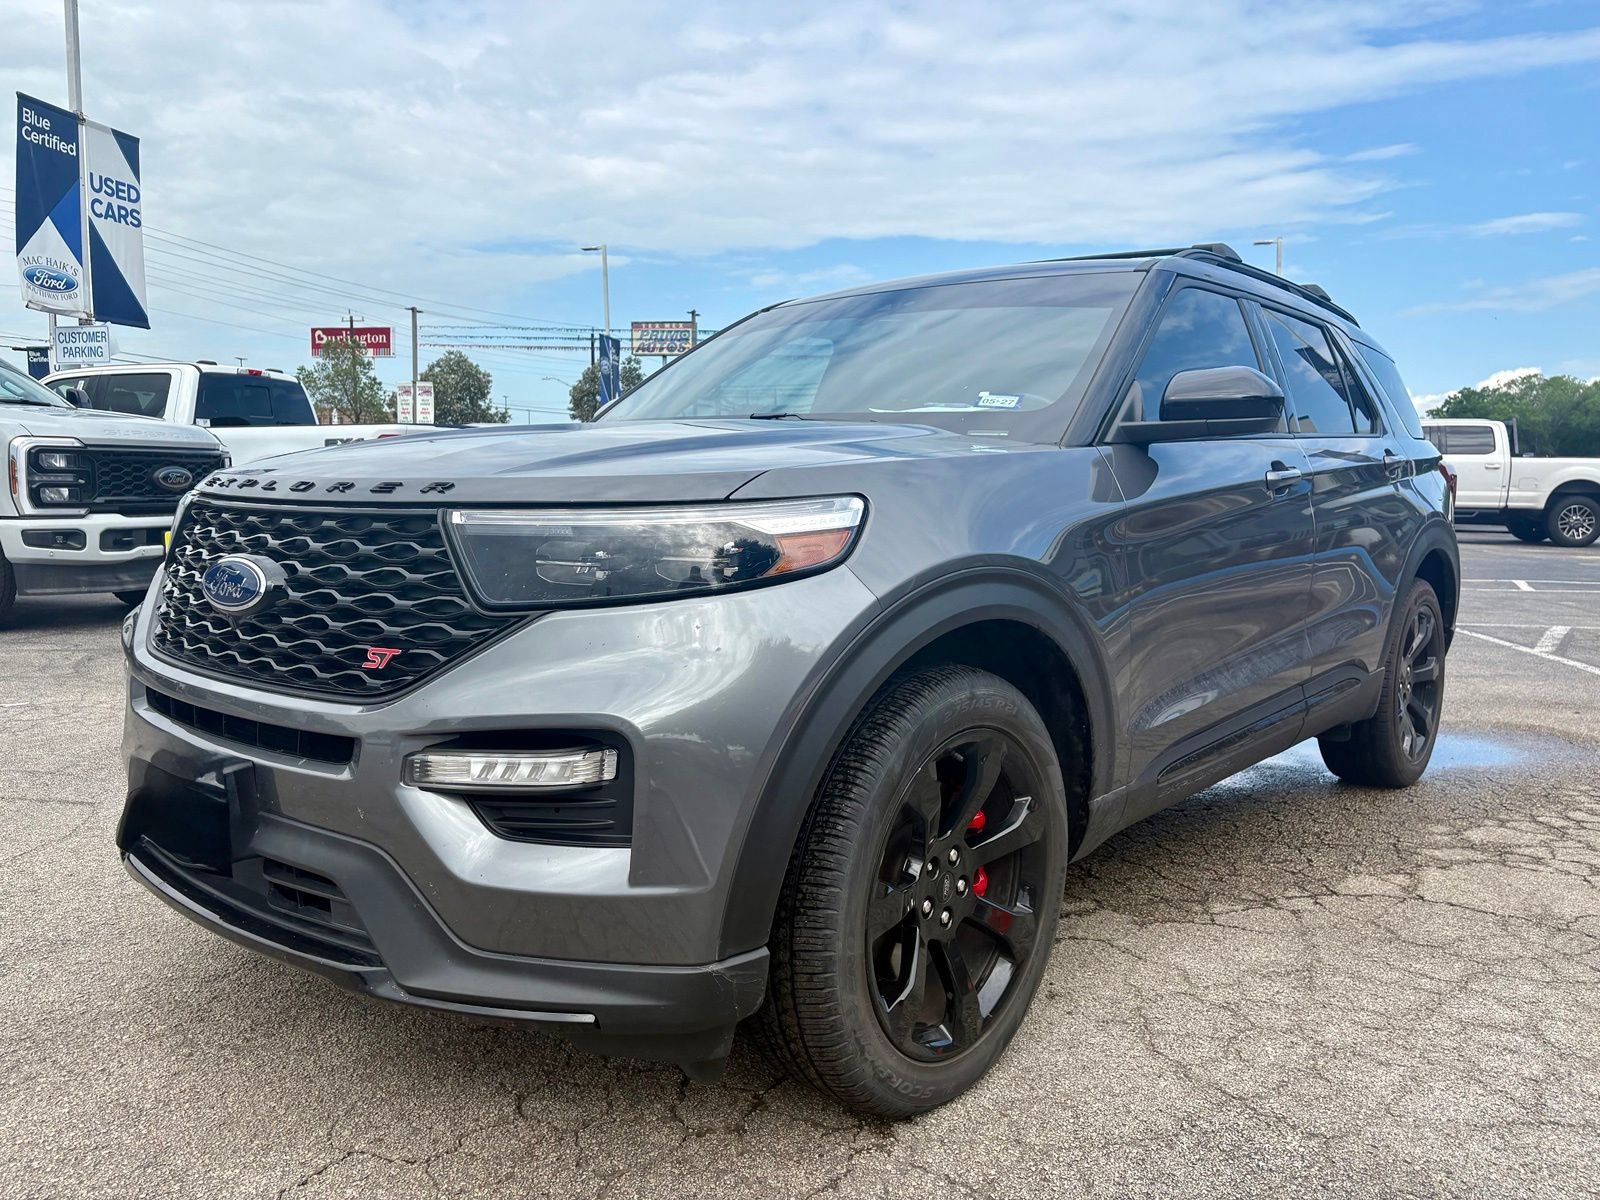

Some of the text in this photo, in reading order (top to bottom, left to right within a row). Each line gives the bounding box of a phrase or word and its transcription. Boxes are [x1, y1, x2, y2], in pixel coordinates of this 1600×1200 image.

[22, 107, 51, 131] Blue
[21, 125, 77, 157] Certified
[89, 171, 141, 204] USED
[90, 197, 142, 228] CARS
[22, 255, 79, 277] MAC HAIK'S
[33, 268, 67, 290] Ford
[25, 282, 78, 301] SOUTHWAY FORD
[57, 331, 107, 344] CUSTOMER
[639, 329, 690, 342] PRIMO
[62, 346, 104, 358] PARKING
[635, 341, 688, 353] AUTOS
[204, 476, 456, 495] EXPLORER
[204, 564, 247, 599] Ford
[361, 647, 402, 669] ST
